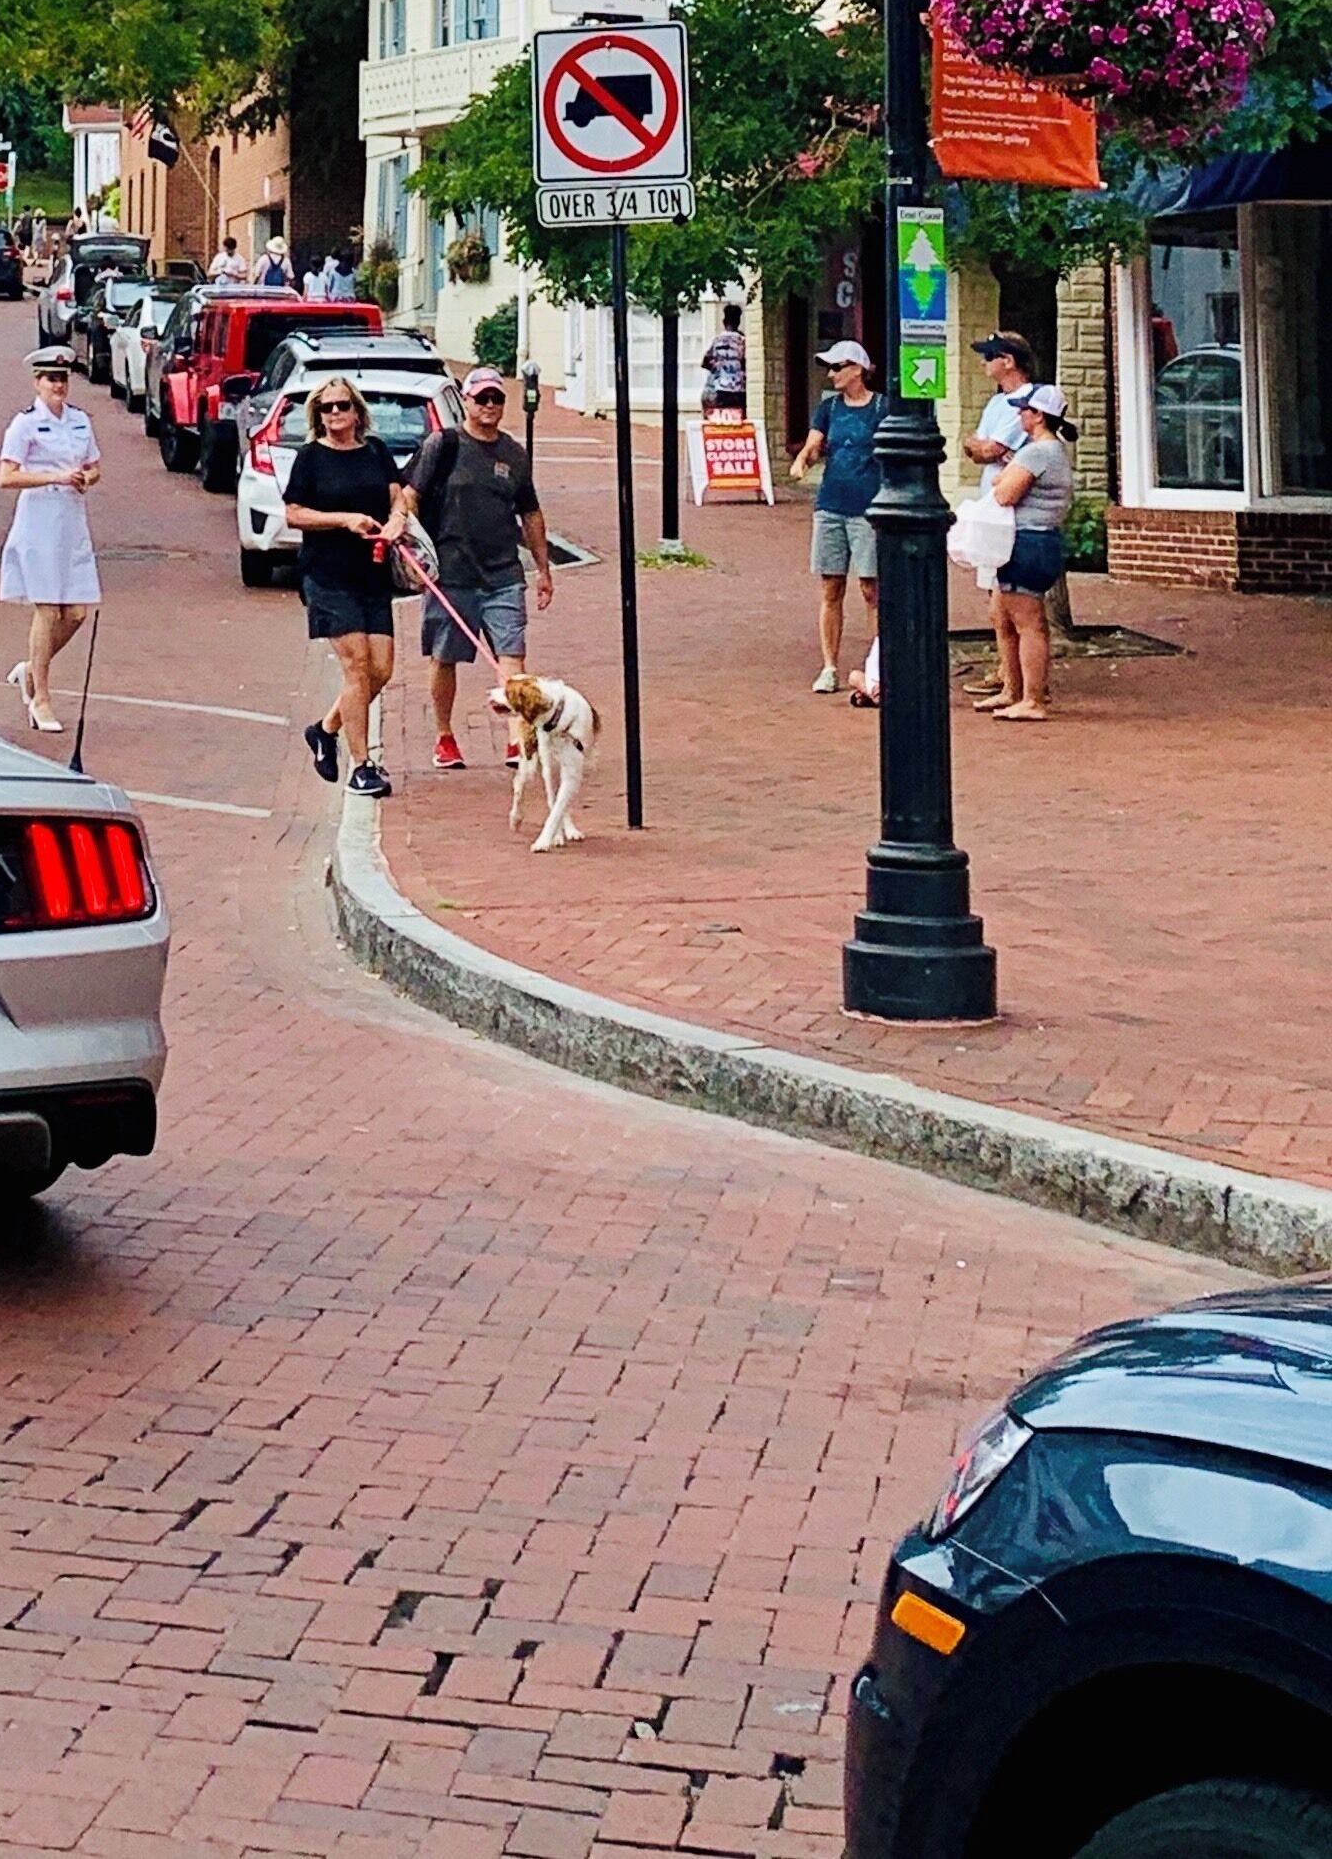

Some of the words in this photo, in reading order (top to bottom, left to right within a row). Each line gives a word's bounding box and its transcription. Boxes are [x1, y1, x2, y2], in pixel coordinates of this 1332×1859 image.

[549, 193, 596, 219] OVER
[606, 191, 638, 217] 3/4
[648, 188, 682, 214] TON
[705, 438, 755, 451] STORE
[706, 451, 757, 461] CLOSING
[711, 461, 755, 475] SALE
